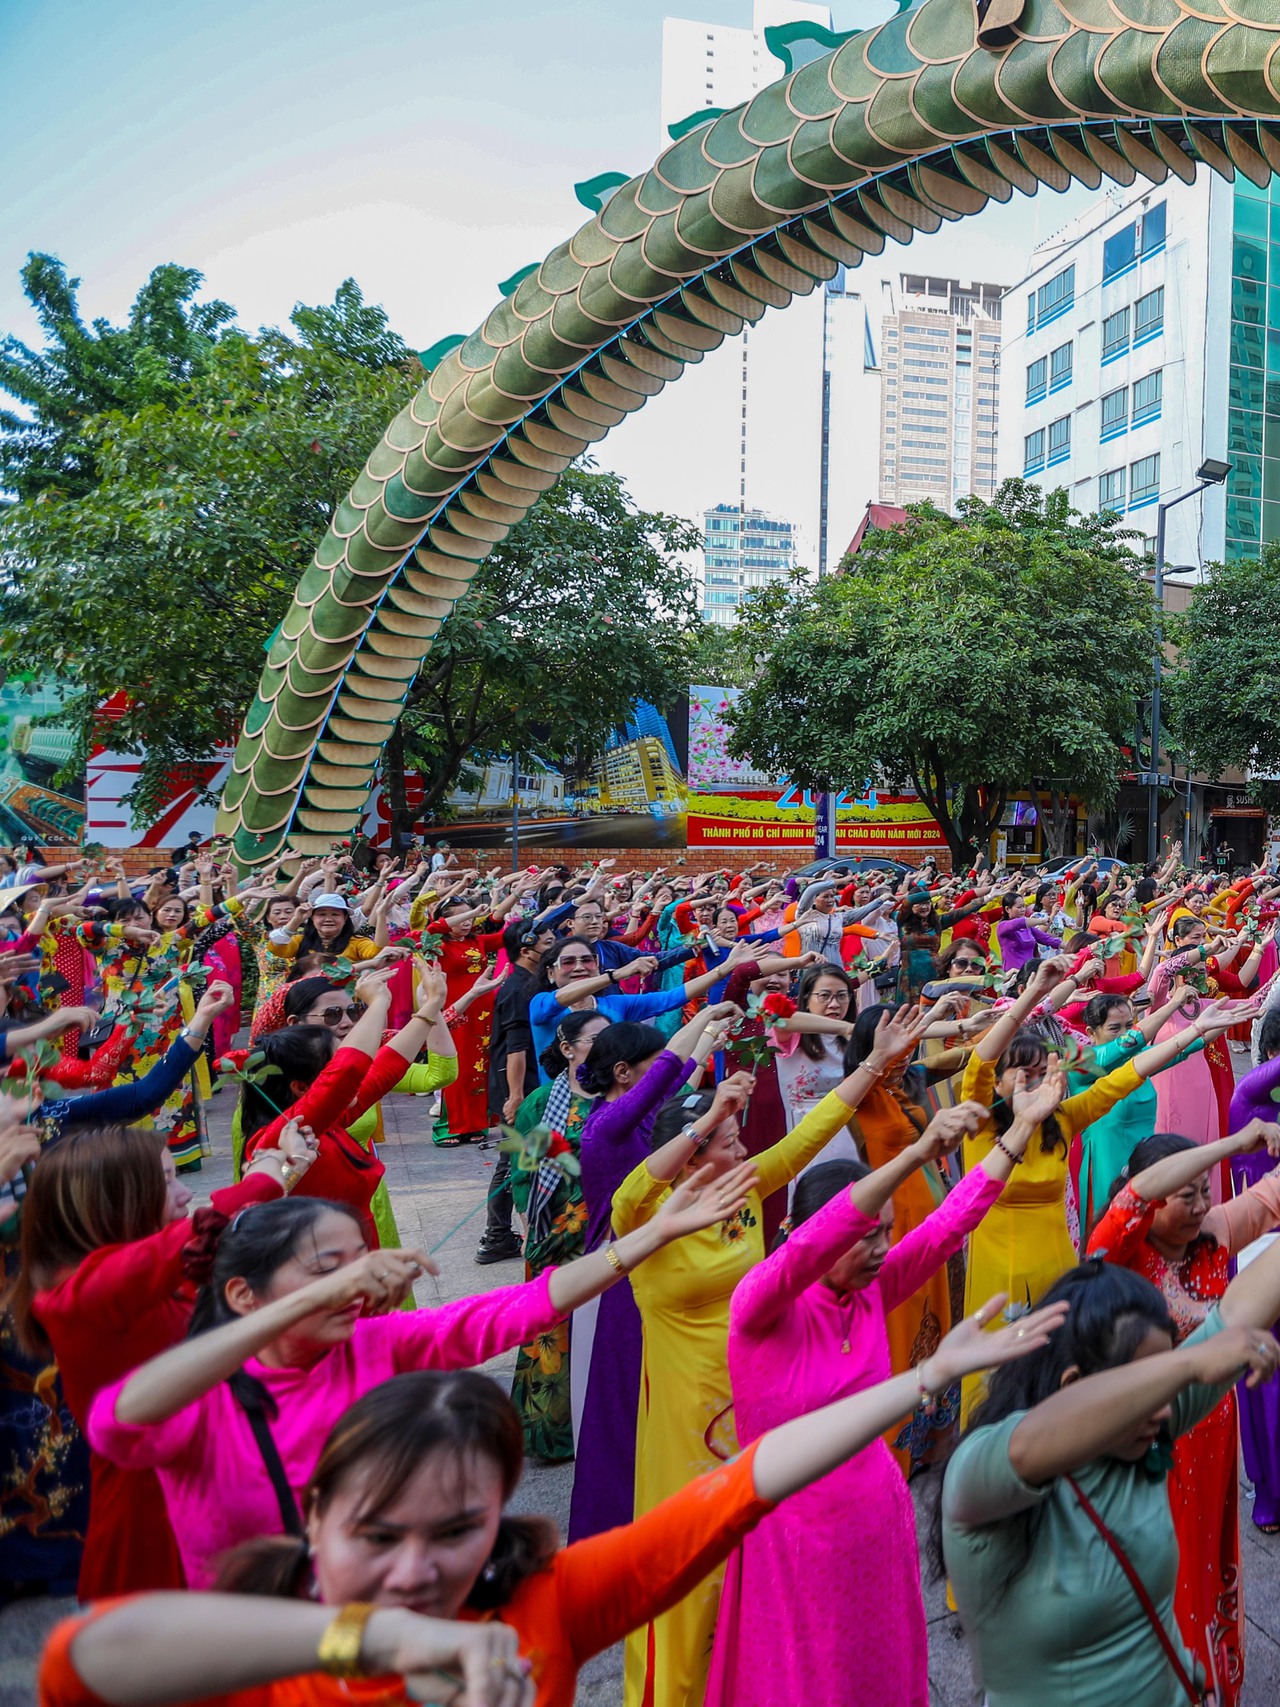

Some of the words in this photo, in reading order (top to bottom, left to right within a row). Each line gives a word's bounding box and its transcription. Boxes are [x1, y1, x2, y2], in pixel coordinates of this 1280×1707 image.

[702, 826, 731, 838] THÀNH
[733, 825, 751, 838] PHỐ
[766, 826, 780, 838] CHÍ
[782, 828, 804, 838] MINH
[848, 827, 869, 838] CHÀO
[870, 827, 886, 839] ĐÓN
[887, 828, 905, 839] NĂM
[907, 828, 922, 839] MỚI
[923, 830, 941, 839] 2024
